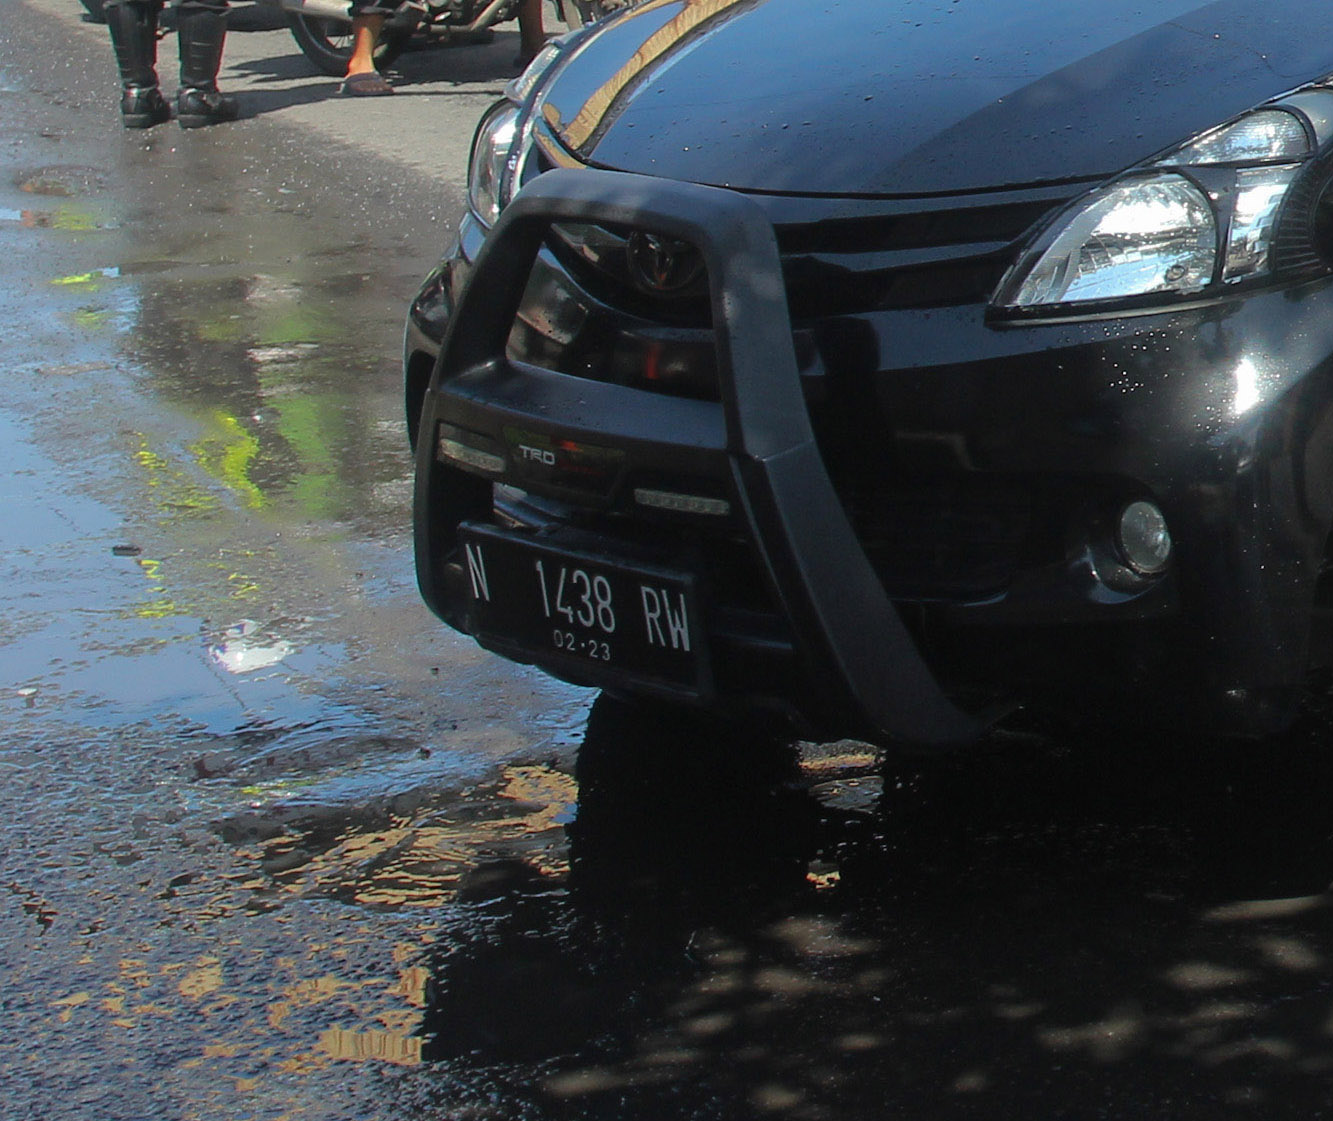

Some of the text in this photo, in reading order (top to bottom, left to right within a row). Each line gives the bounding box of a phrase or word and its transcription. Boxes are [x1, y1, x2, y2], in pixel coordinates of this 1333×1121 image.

[519, 444, 556, 466] TRD
[465, 543, 690, 652] N 1438 RW
